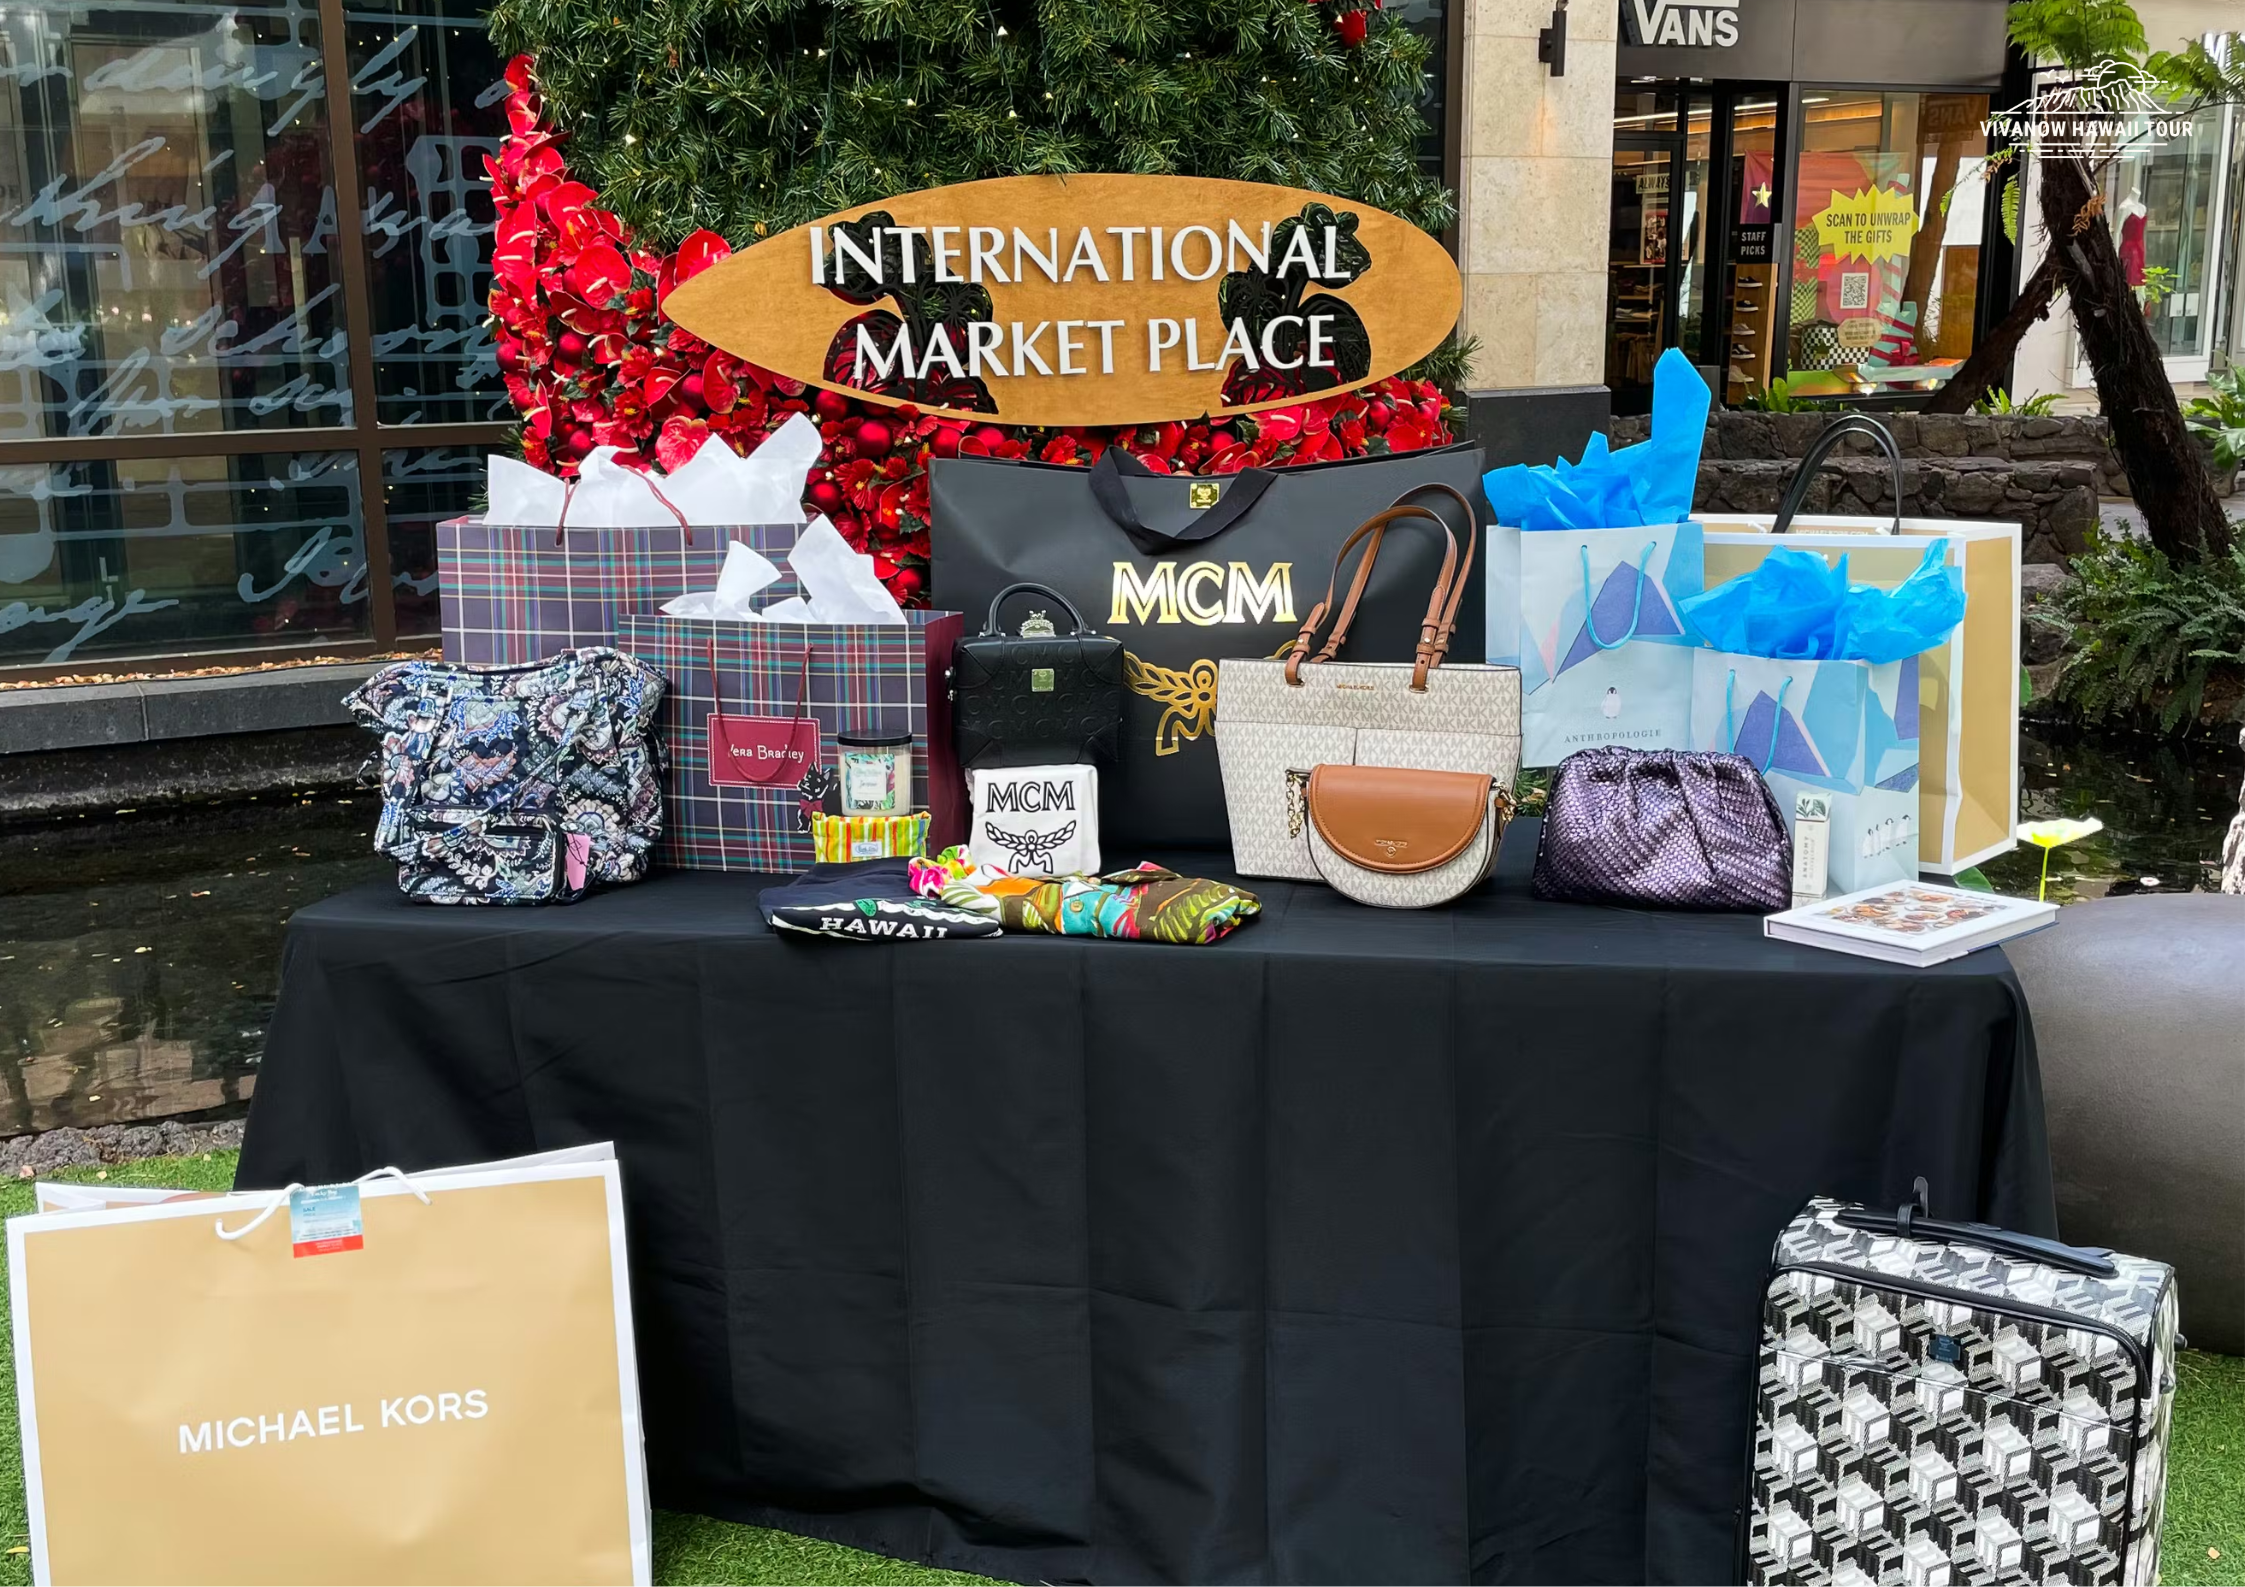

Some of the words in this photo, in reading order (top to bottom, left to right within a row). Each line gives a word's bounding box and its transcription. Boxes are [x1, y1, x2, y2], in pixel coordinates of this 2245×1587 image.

[1634, 0, 1740, 47] VANS
[1638, 174, 1670, 190] ALWAYS
[1826, 213, 1852, 228] SCAN
[1855, 213, 1867, 227] TO
[1870, 212, 1911, 226] UNWRAP
[1741, 231, 1767, 241] STAFF
[1844, 230, 1862, 244] THE
[1866, 229, 1892, 243] GIFTS
[809, 218, 1352, 285] INTERNATIONAL
[1740, 245, 1766, 256] PICKS
[854, 319, 1126, 381] MARKET
[1148, 313, 1336, 372] PLACE
[1107, 560, 1298, 626] MCM
[1564, 729, 1662, 743] ANTHROPOLOGIE
[985, 780, 1076, 813] MCM
[819, 916, 948, 939] HAWAII
[179, 1403, 364, 1454] MICHAEL
[380, 1389, 489, 1428] KORS
